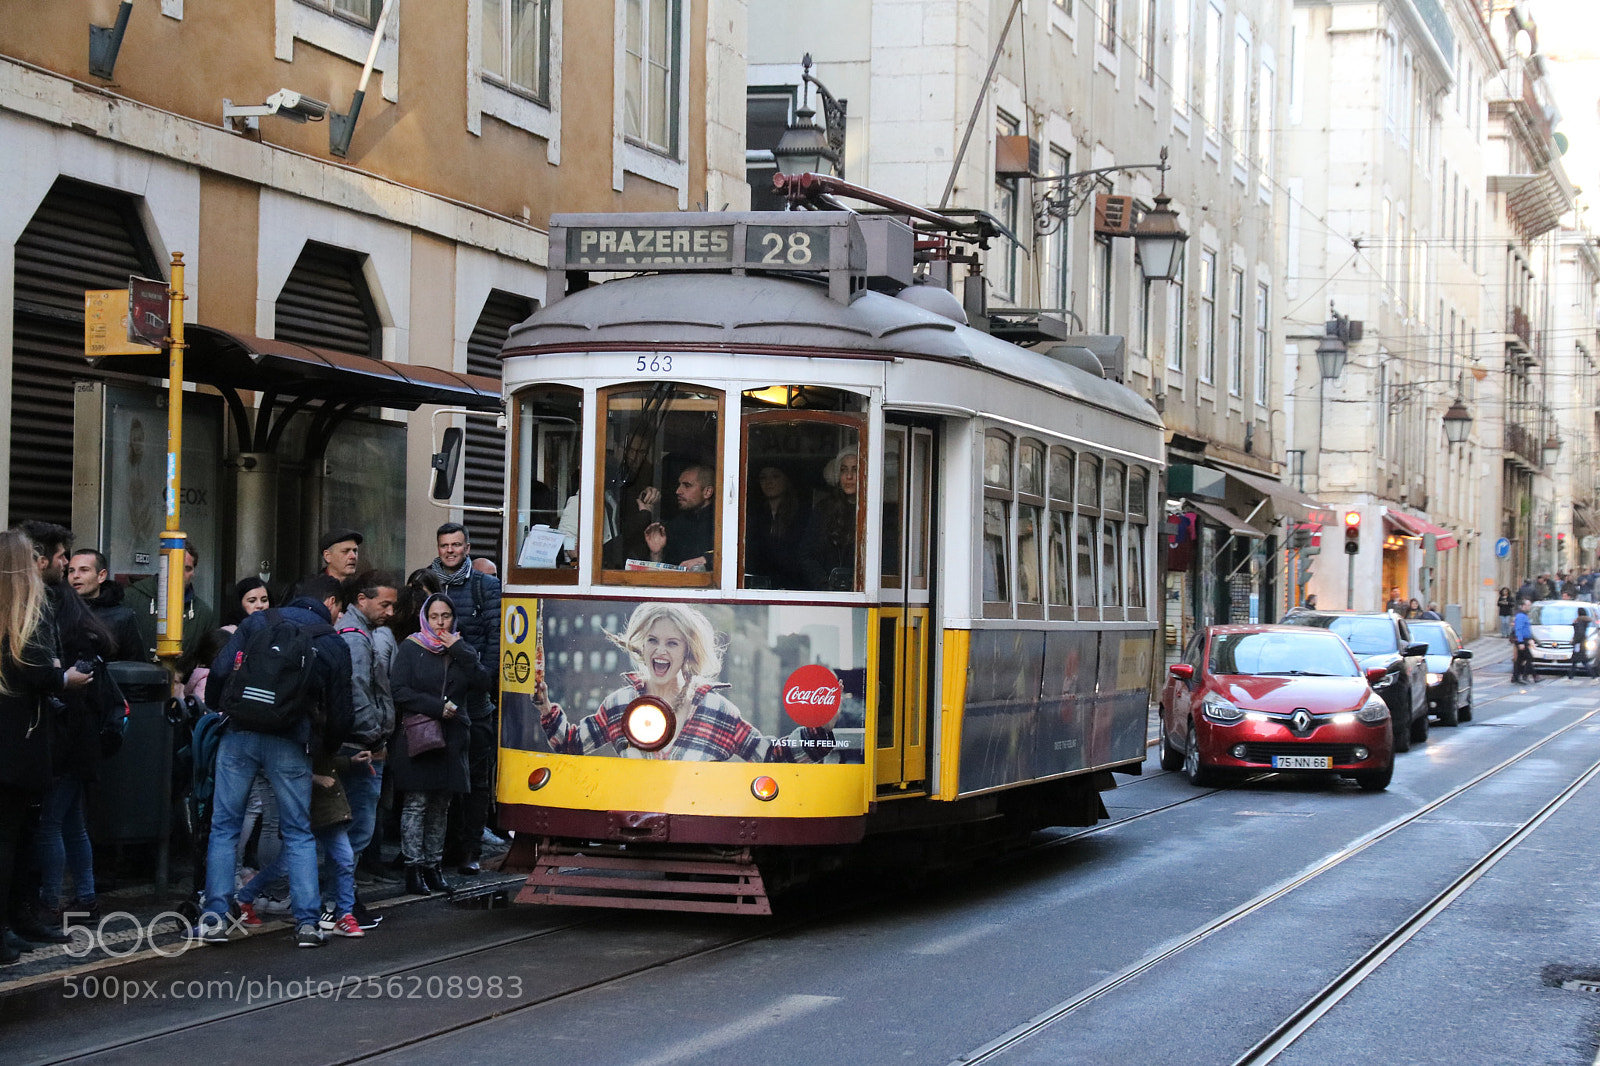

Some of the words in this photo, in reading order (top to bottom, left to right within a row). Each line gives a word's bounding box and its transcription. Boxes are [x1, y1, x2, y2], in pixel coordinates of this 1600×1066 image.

[580, 229, 728, 253] PRAZERES
[761, 232, 813, 265] 28
[636, 355, 673, 372] 563
[785, 686, 838, 705] Coca-Cola
[771, 739, 797, 747] TASTE
